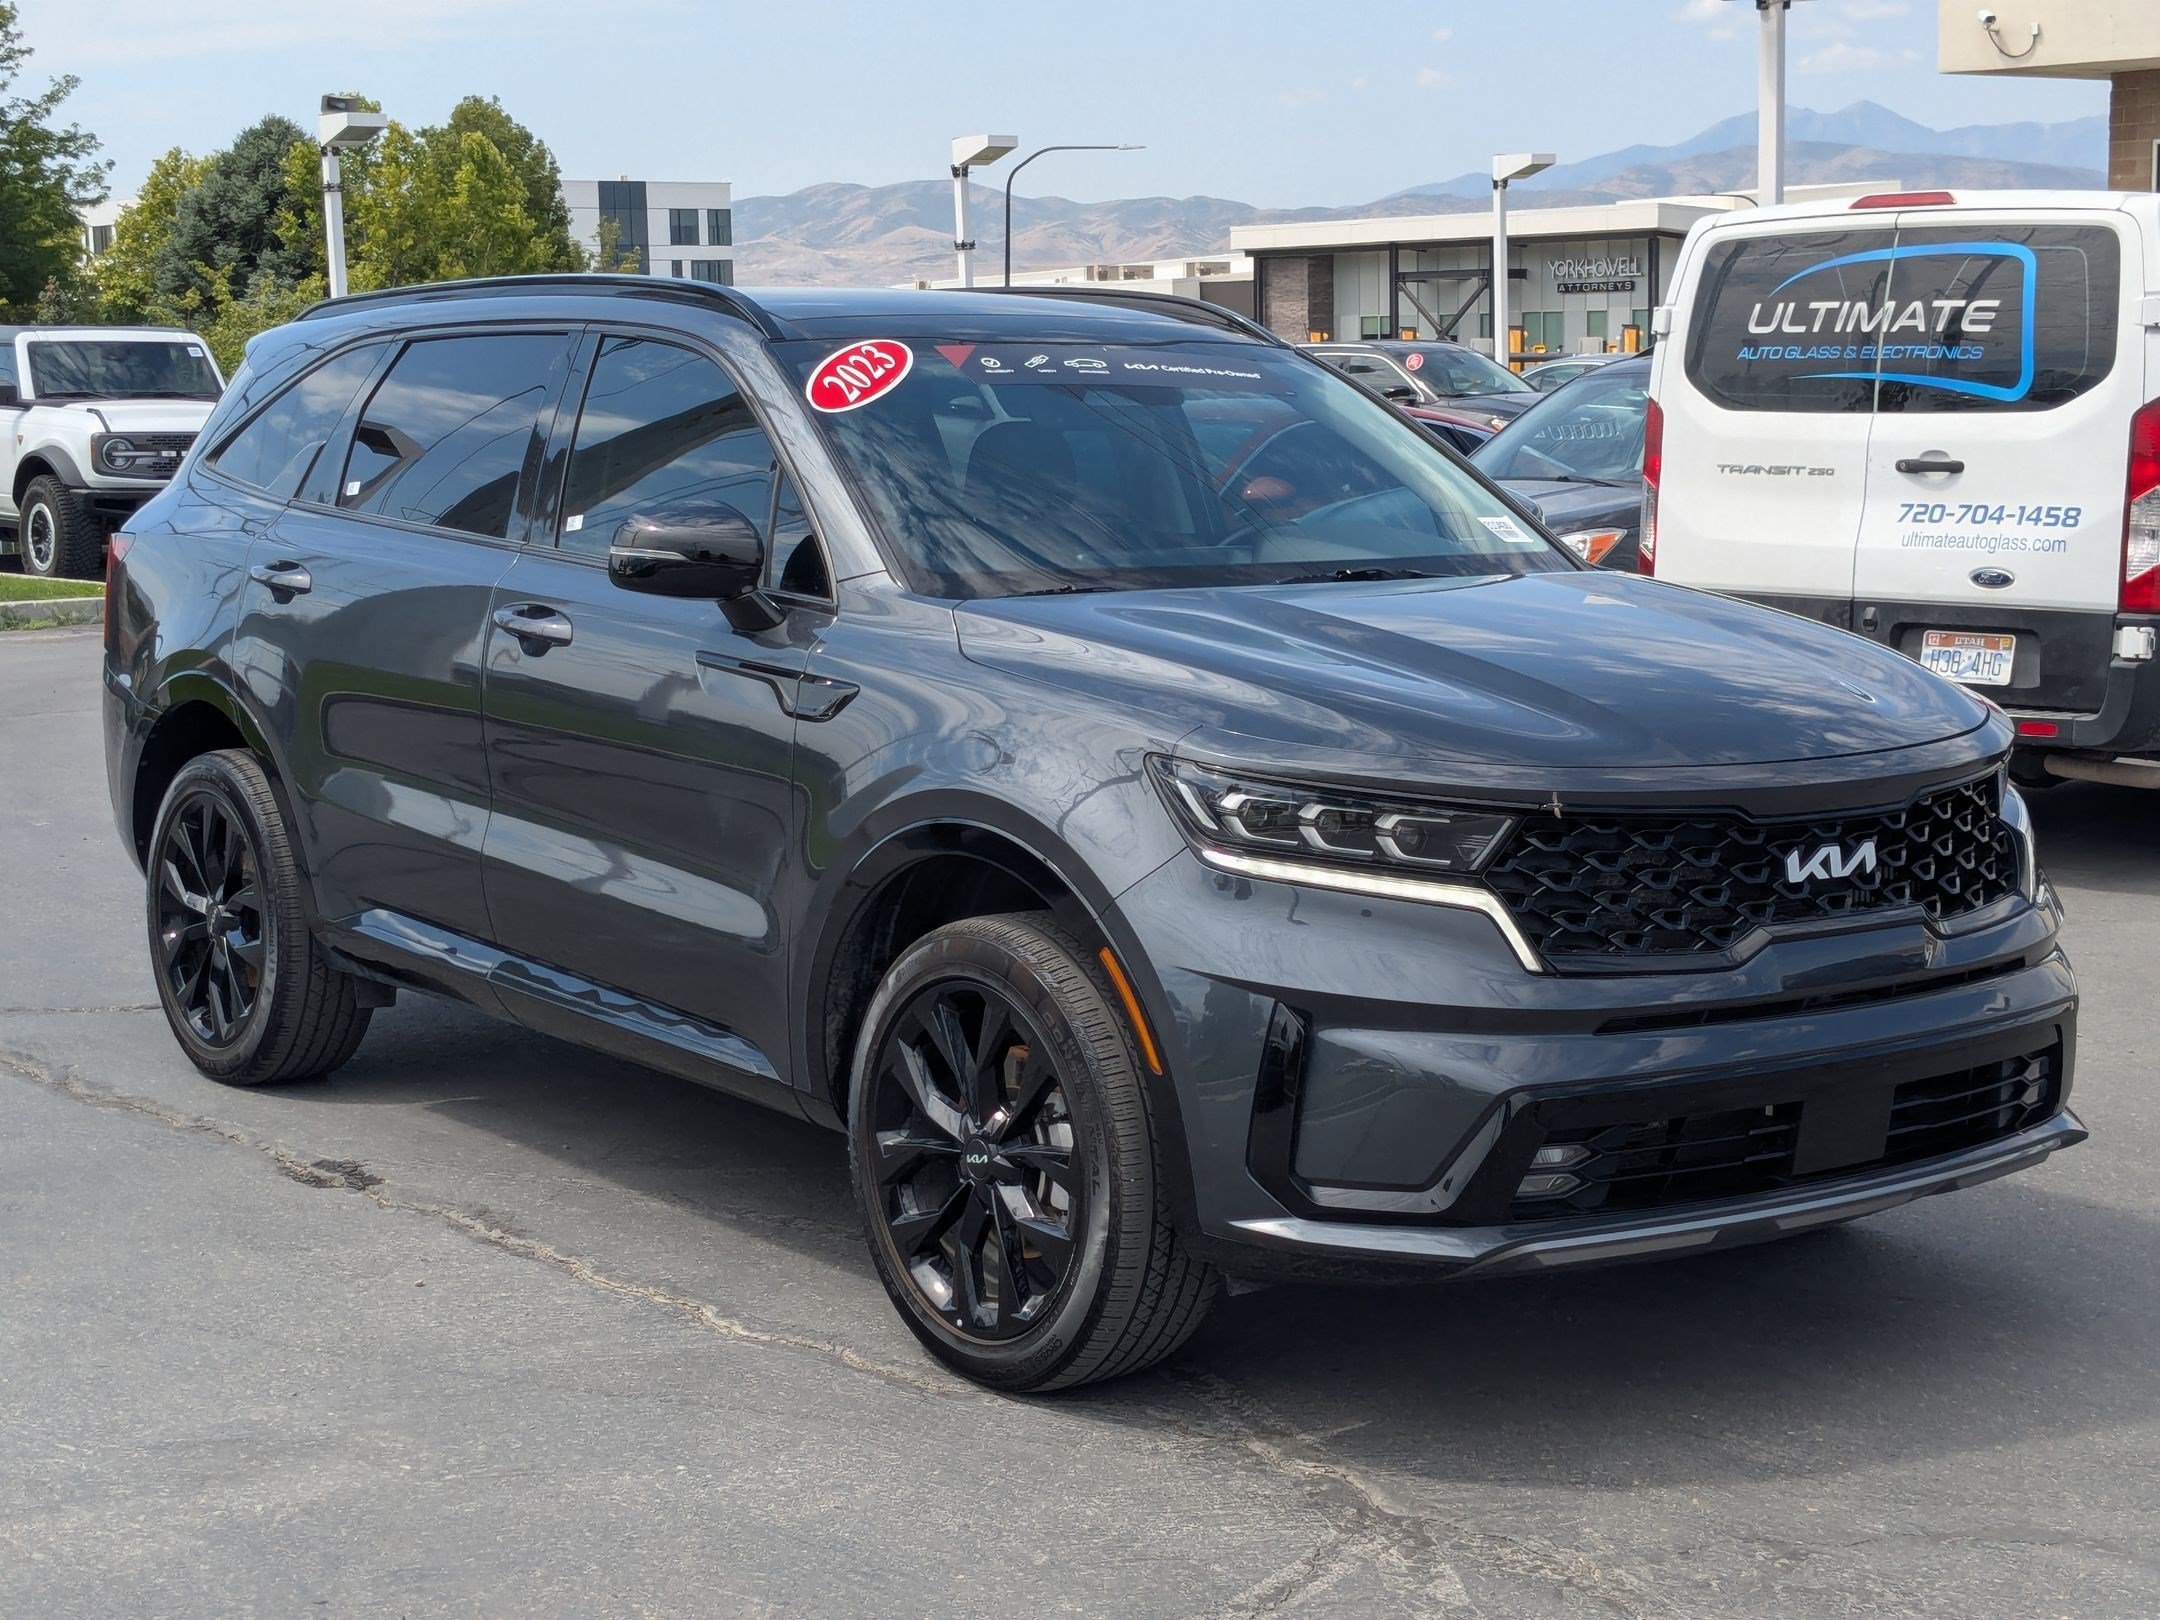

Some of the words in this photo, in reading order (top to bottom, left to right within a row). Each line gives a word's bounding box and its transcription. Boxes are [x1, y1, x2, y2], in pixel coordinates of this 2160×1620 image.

[1558, 282, 1632, 292] ATTORNEYS
[1748, 300, 2000, 334] ULTIMATE
[1737, 347, 1783, 361] AUTO
[1784, 346, 1841, 360] GLASS
[1843, 346, 1857, 359] &
[1860, 346, 1985, 360] ELECTRONICS
[822, 345, 896, 403] 2023
[1161, 364, 1206, 375] Certified
[1717, 464, 1806, 476] TRANSIT
[1807, 467, 1835, 476] 250
[1897, 503, 2082, 528] 720-704-1458
[1901, 531, 2067, 554] ultimateautoglass.com
[1954, 636, 1985, 647] UTAH
[1787, 841, 1877, 883] KIA
[966, 1153, 989, 1164] KIA
